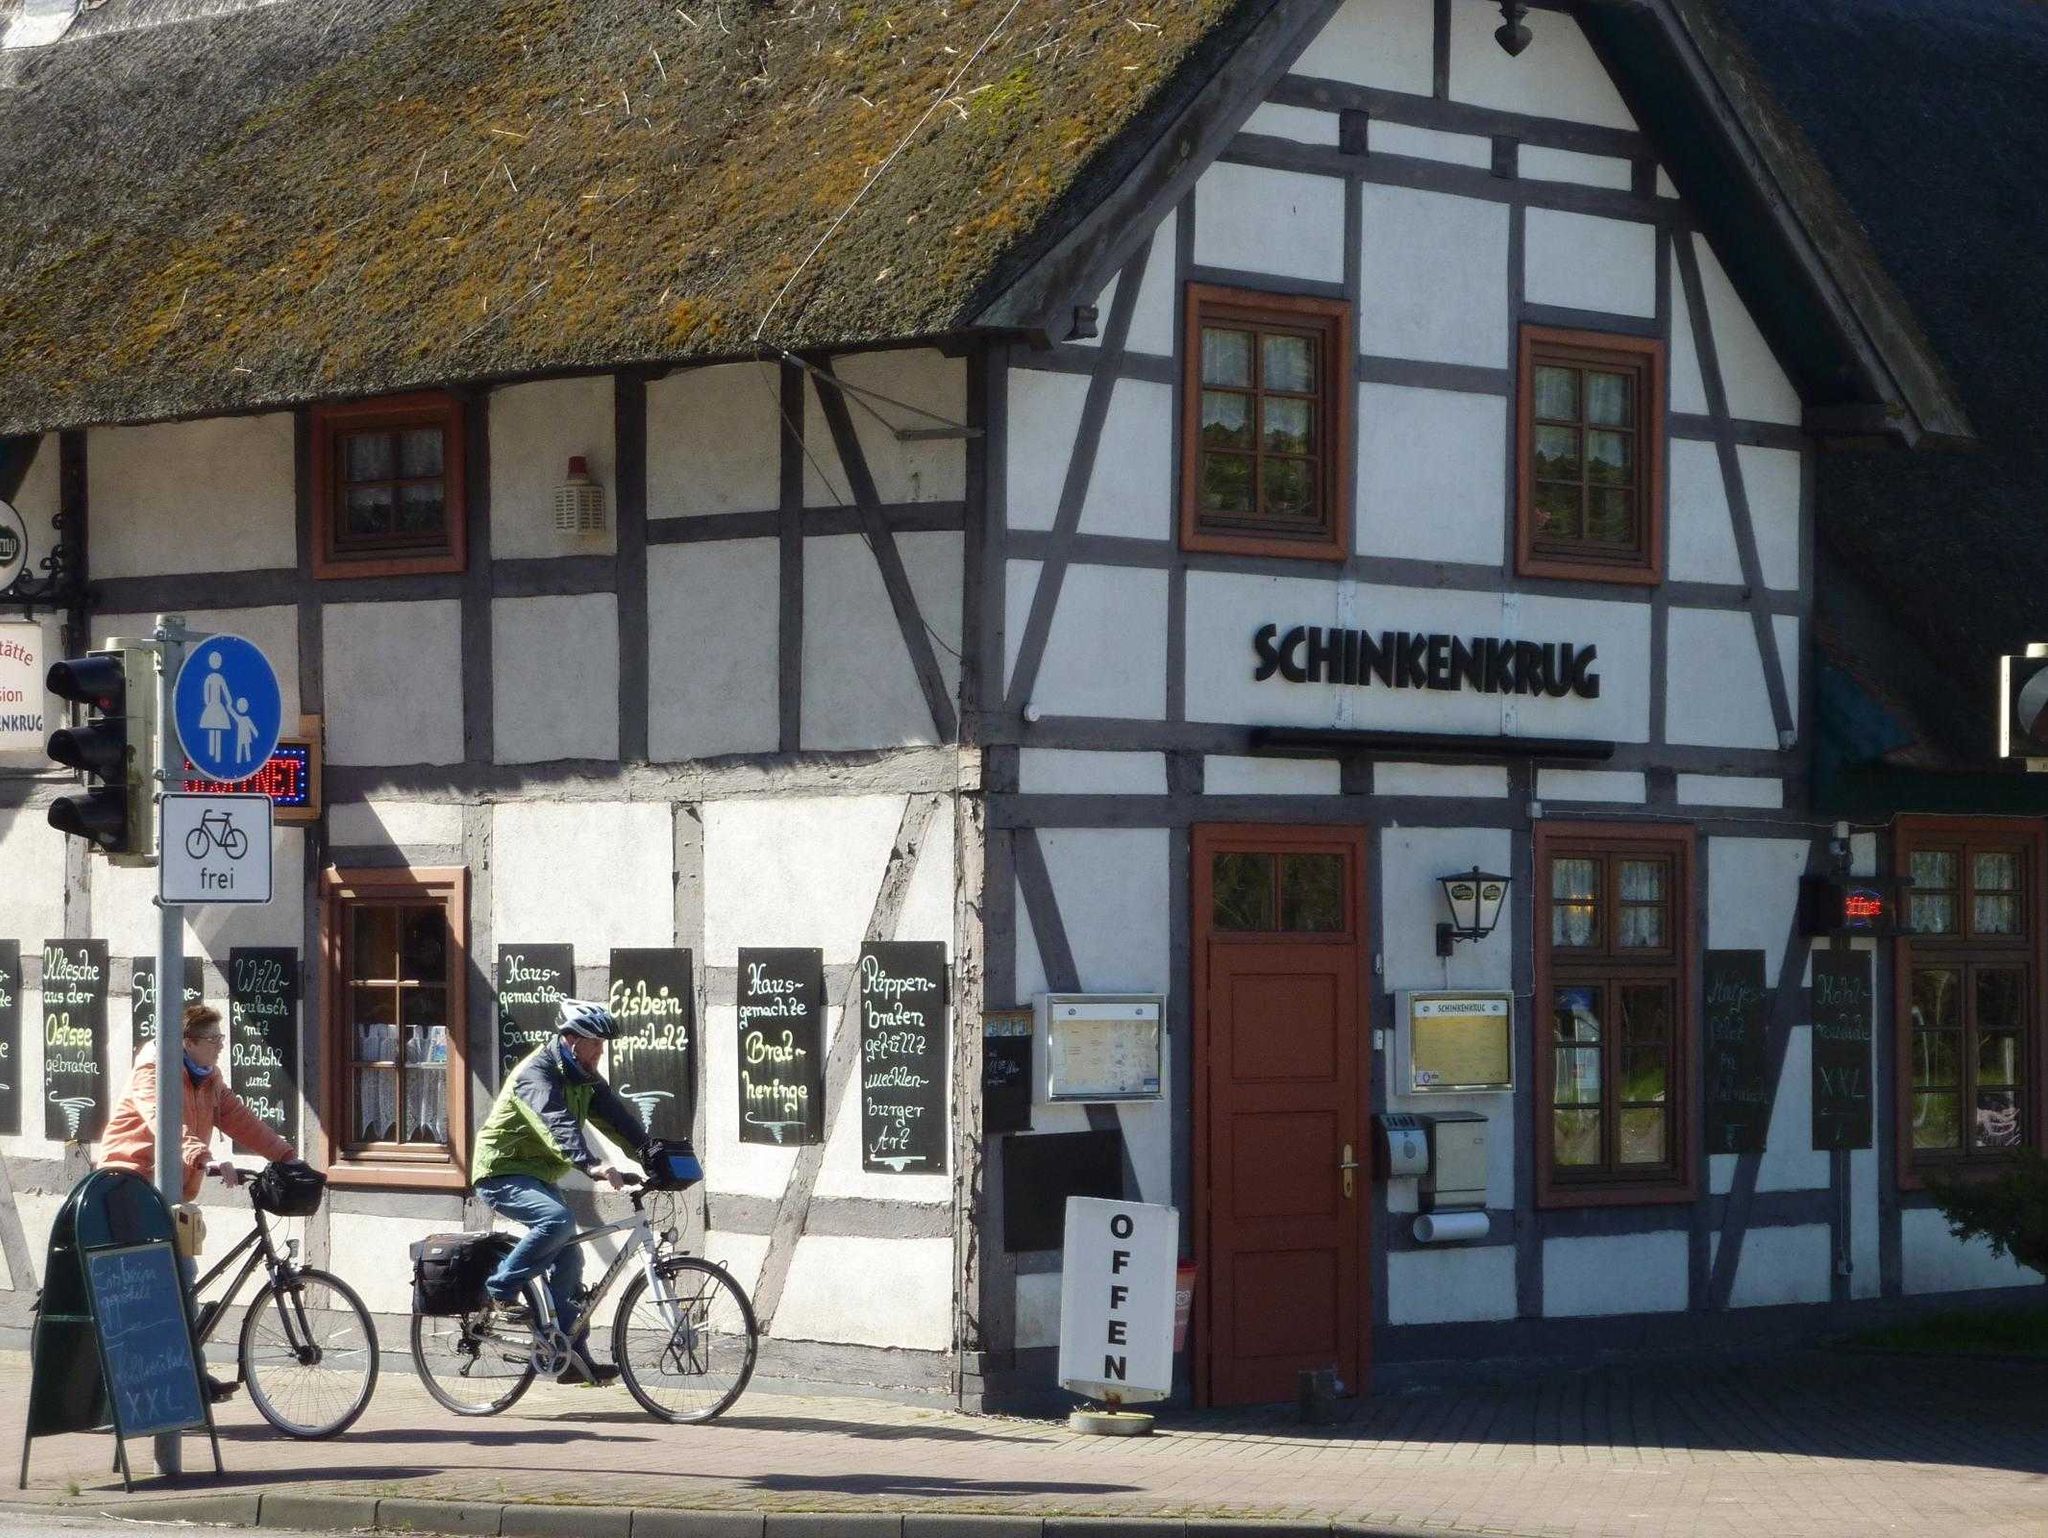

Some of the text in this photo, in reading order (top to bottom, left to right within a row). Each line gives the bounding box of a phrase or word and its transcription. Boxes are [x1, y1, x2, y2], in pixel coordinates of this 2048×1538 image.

[1254, 623, 1600, 699] SCHINKENKRUG
[200, 867, 234, 889] frei
[505, 955, 560, 984] Haus-
[747, 963, 804, 996] Haus-
[862, 954, 937, 999] Rippen-
[44, 983, 95, 1004] aus der
[610, 979, 683, 1018] Eisbein
[46, 1012, 93, 1047] Ostsee
[244, 1021, 269, 1036] mit
[740, 997, 808, 1030] gemachte
[865, 1000, 926, 1029] braten
[232, 1043, 283, 1068] Rotkohl
[612, 1023, 689, 1067] gepökelt
[746, 1030, 807, 1064] Brat-
[865, 1031, 927, 1062] gefüllt
[46, 1050, 100, 1086] gebraten
[245, 1071, 273, 1088] und
[742, 1070, 808, 1113] heringe
[868, 1097, 926, 1128] burger
[870, 1125, 911, 1154] Art
[1103, 1212, 1135, 1382] OFFEN
[125, 1386, 185, 1423] XXL
